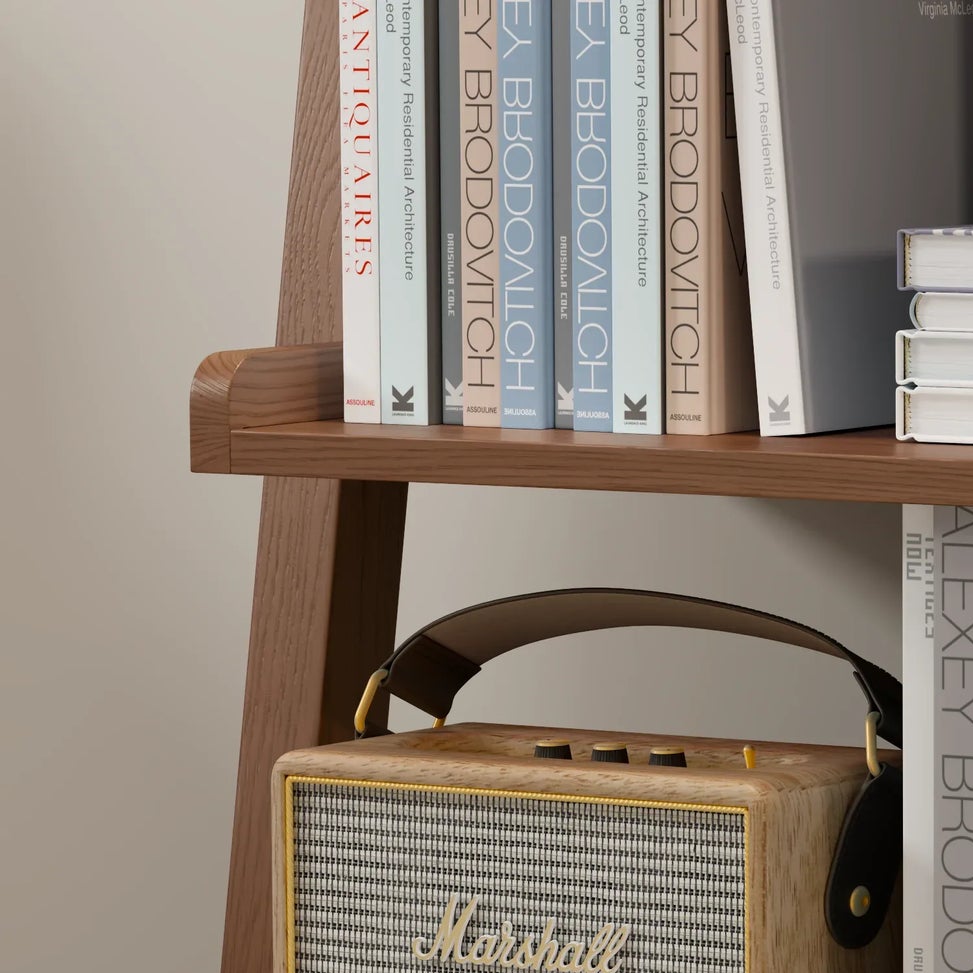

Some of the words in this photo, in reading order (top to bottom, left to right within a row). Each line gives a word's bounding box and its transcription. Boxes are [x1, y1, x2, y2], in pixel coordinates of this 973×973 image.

[918, 1, 948, 19] Virginia
[349, 2, 372, 275] ANTIQUAIRES
[403, 93, 415, 180] Residential
[636, 96, 648, 184] Residential
[758, 102, 775, 191] Residential
[404, 186, 415, 280] Architecture
[464, 70, 495, 387] BRODOVITCH
[638, 190, 649, 287] Architecture
[669, 72, 700, 394] BRODOVITCH
[765, 195, 781, 290] Architecture
[447, 287, 455, 316] COLE
[346, 399, 375, 407] ASSOULINE
[466, 406, 498, 414] ASSOULINE
[670, 413, 702, 422] ASSOULINE
